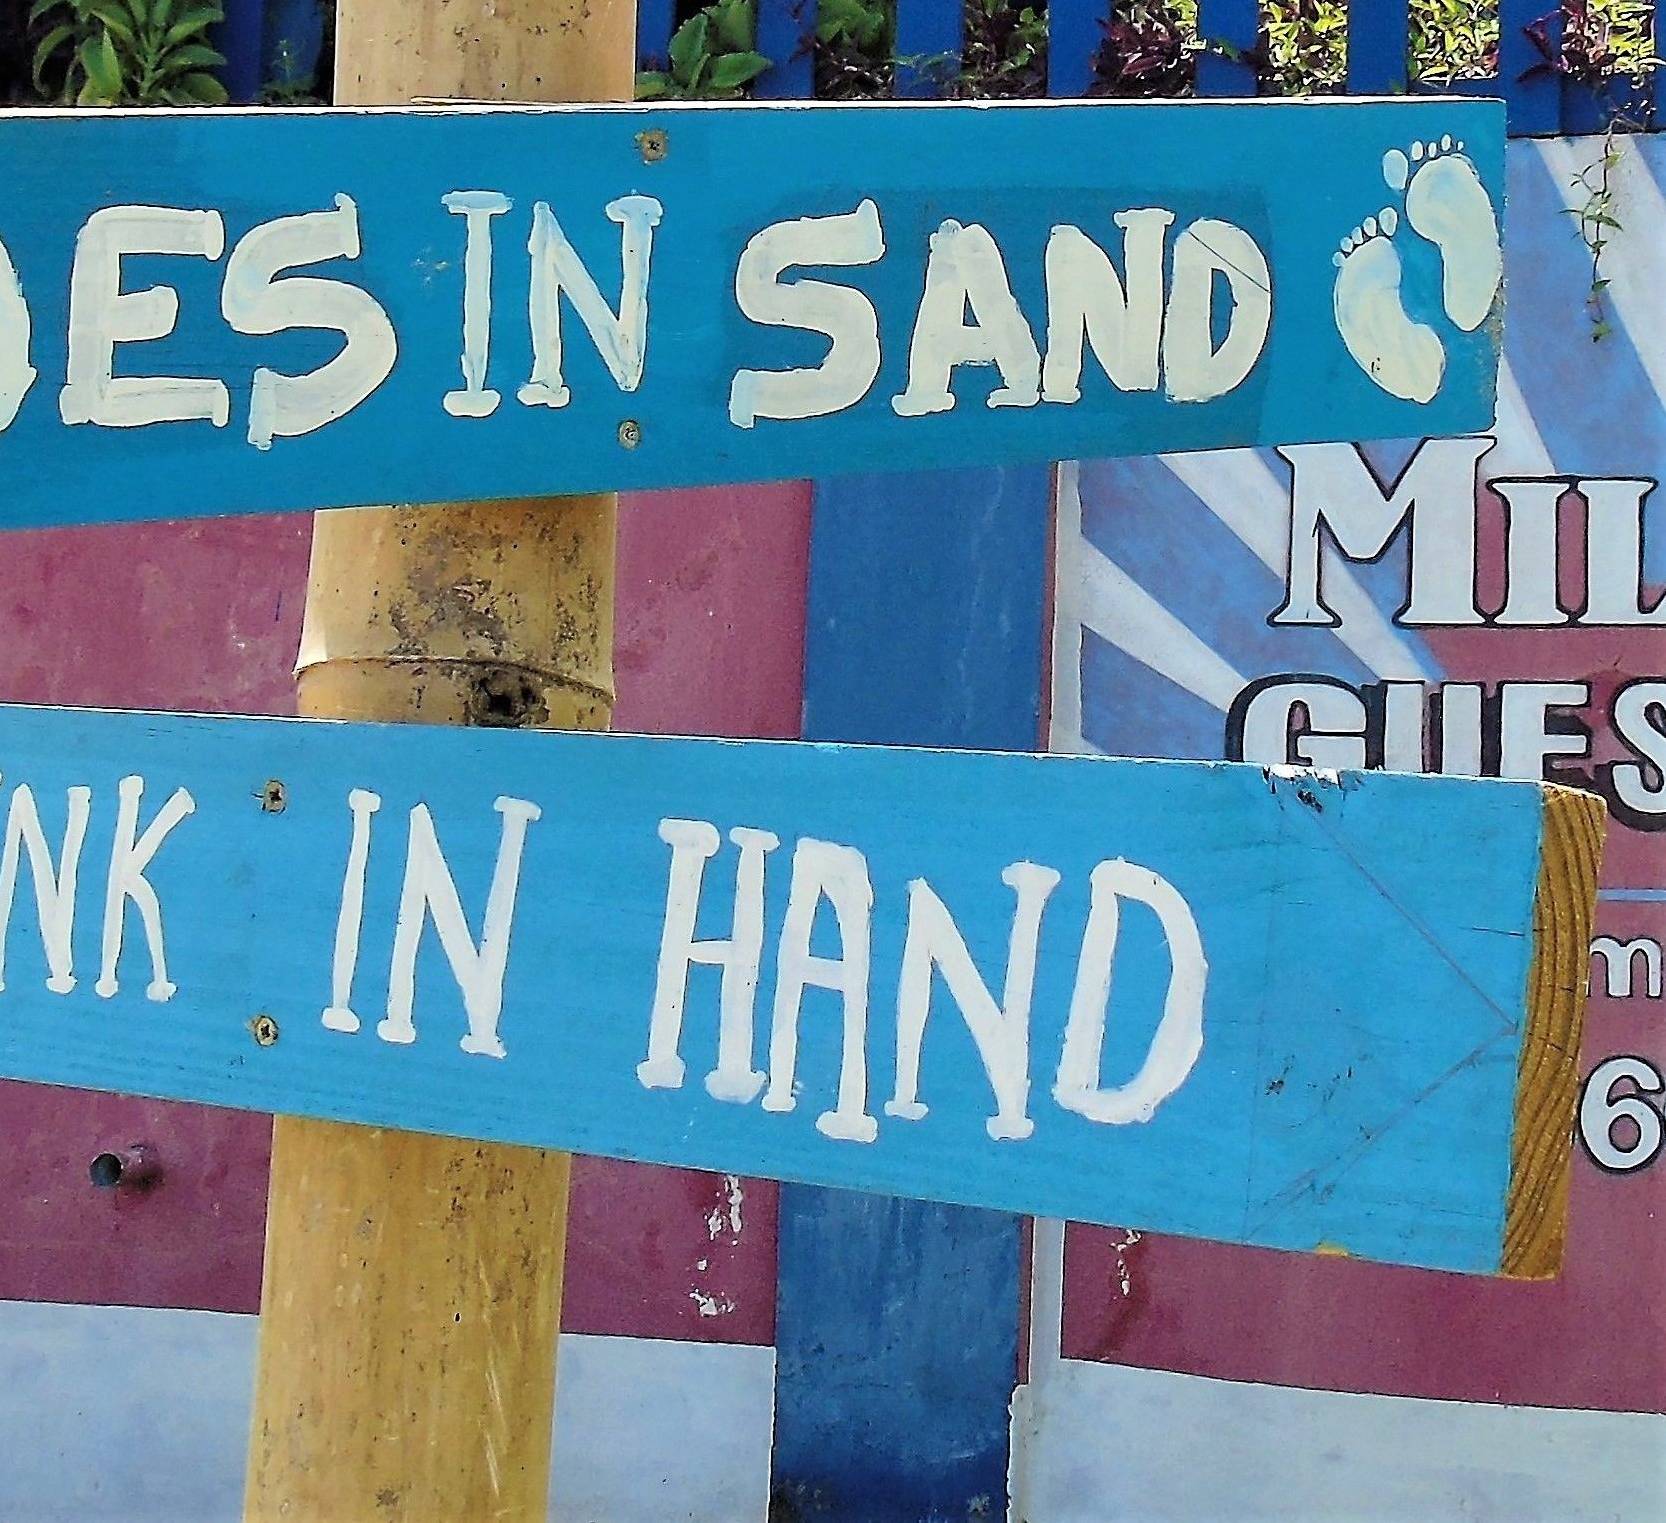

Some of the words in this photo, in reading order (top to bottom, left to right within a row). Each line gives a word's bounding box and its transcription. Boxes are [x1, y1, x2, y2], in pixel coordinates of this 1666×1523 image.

[441, 189, 663, 418] IN
[728, 198, 1271, 428] SAND
[322, 788, 542, 1059] IN
[636, 817, 1209, 1143] HAND
